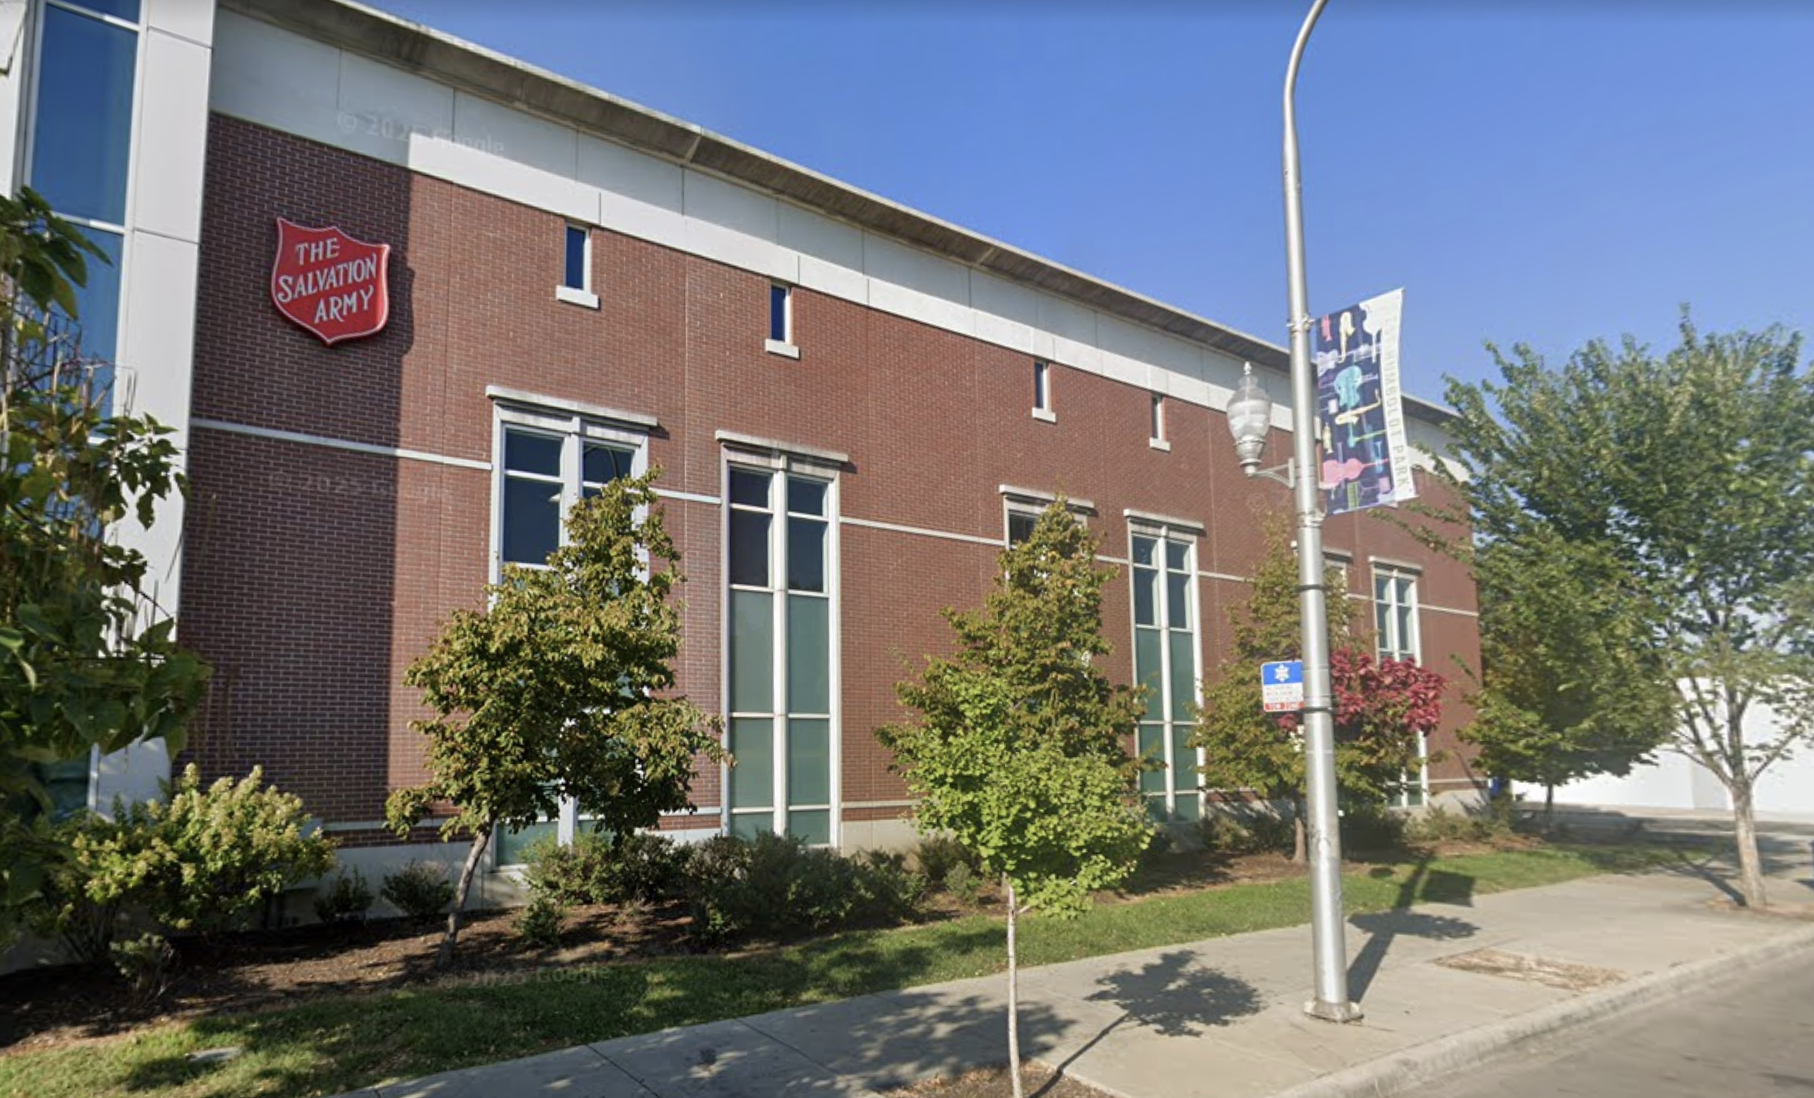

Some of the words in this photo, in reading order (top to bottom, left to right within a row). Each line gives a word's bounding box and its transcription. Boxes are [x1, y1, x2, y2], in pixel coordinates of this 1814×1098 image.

[296, 238, 340, 265] THE
[277, 253, 377, 303] SALVATION
[314, 285, 374, 324] ARMY
[1384, 350, 1402, 436] HUMBOLDT
[1392, 445, 1410, 487] PARK
